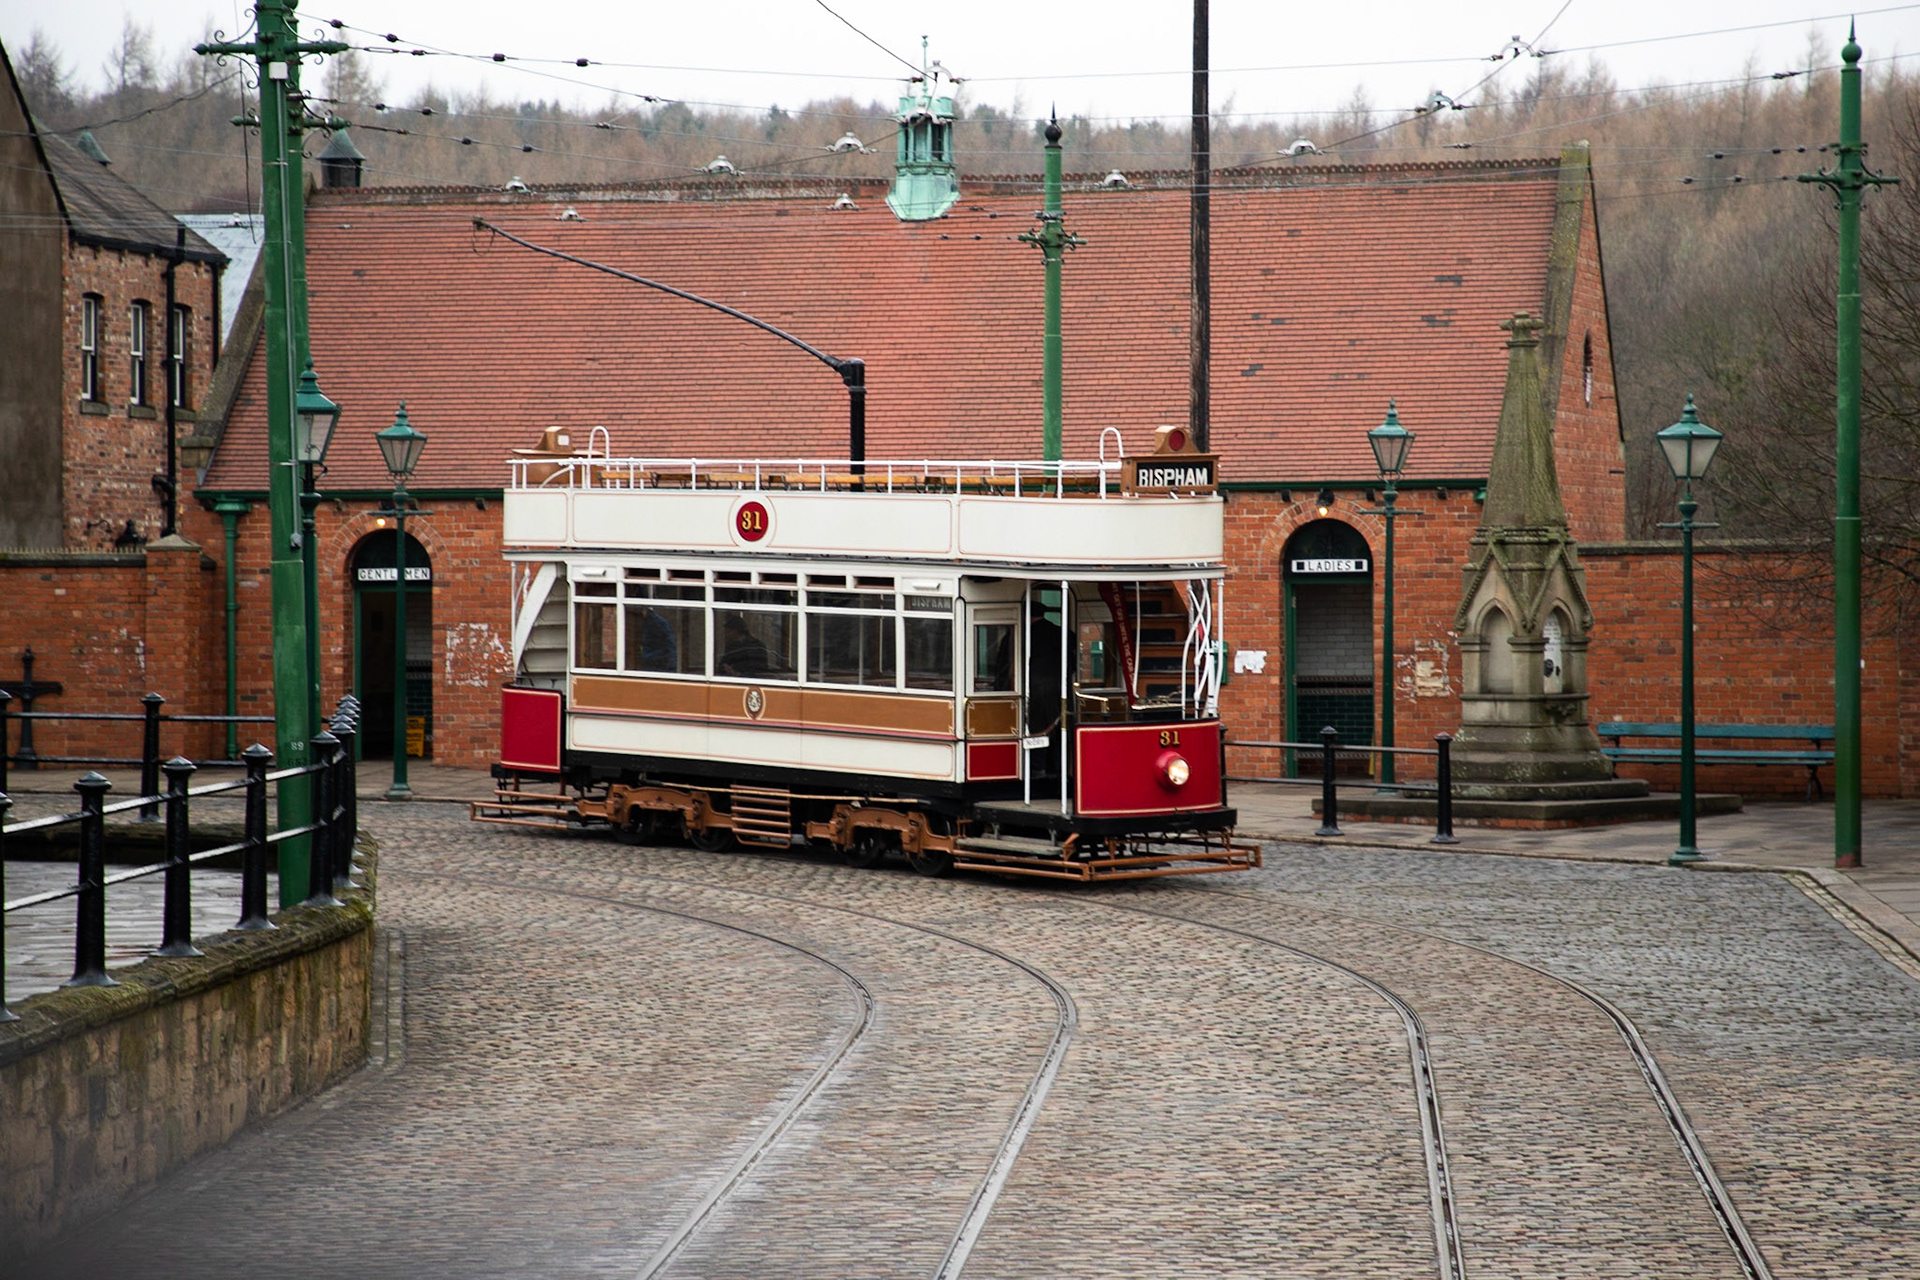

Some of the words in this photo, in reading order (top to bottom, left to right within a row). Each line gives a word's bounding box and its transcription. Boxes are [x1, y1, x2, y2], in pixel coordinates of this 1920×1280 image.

[1138, 467, 1208, 487] BISPHAM
[741, 510, 762, 531] 31
[360, 568, 428, 579] GENTLMEN
[1308, 561, 1352, 571] LADIES
[1160, 730, 1180, 747] 31
